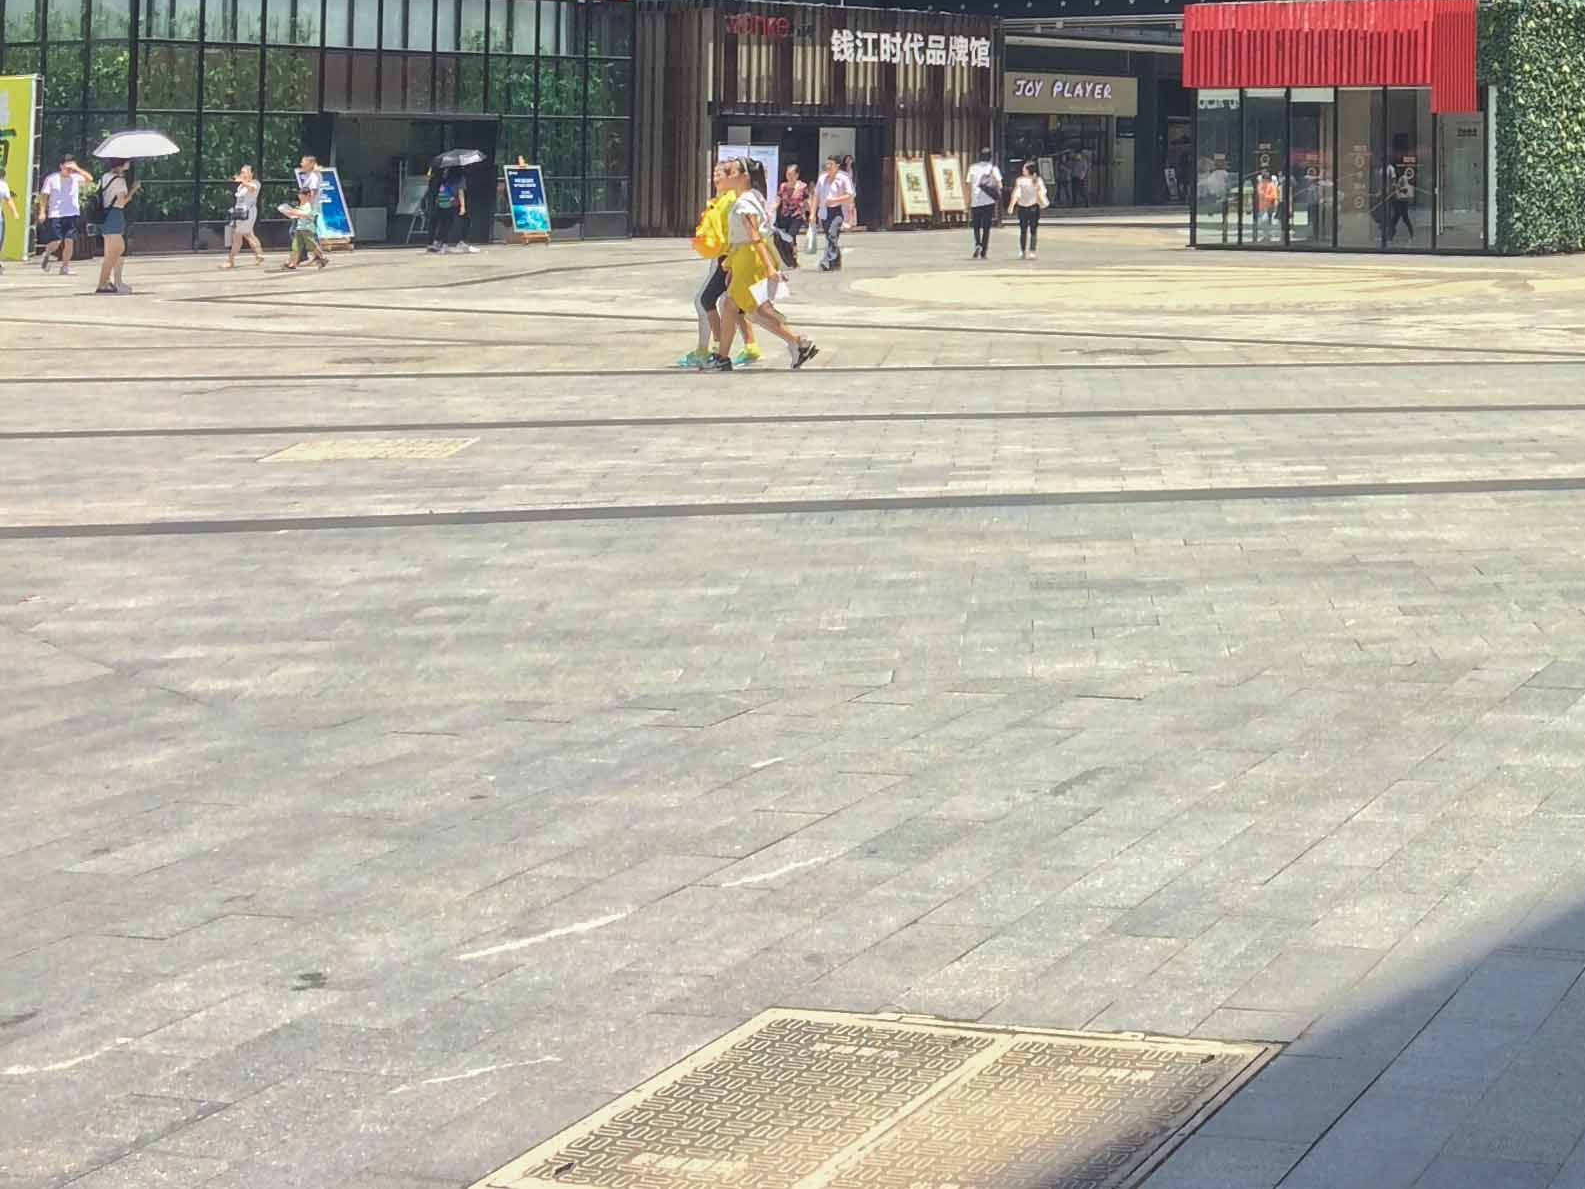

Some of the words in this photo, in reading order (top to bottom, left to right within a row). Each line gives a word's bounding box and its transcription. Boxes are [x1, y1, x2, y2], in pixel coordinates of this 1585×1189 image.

[831, 28, 990, 68] 钱江时代品牌馆
[1015, 79, 1043, 98] JOY
[1053, 80, 1112, 100] PLAYER
